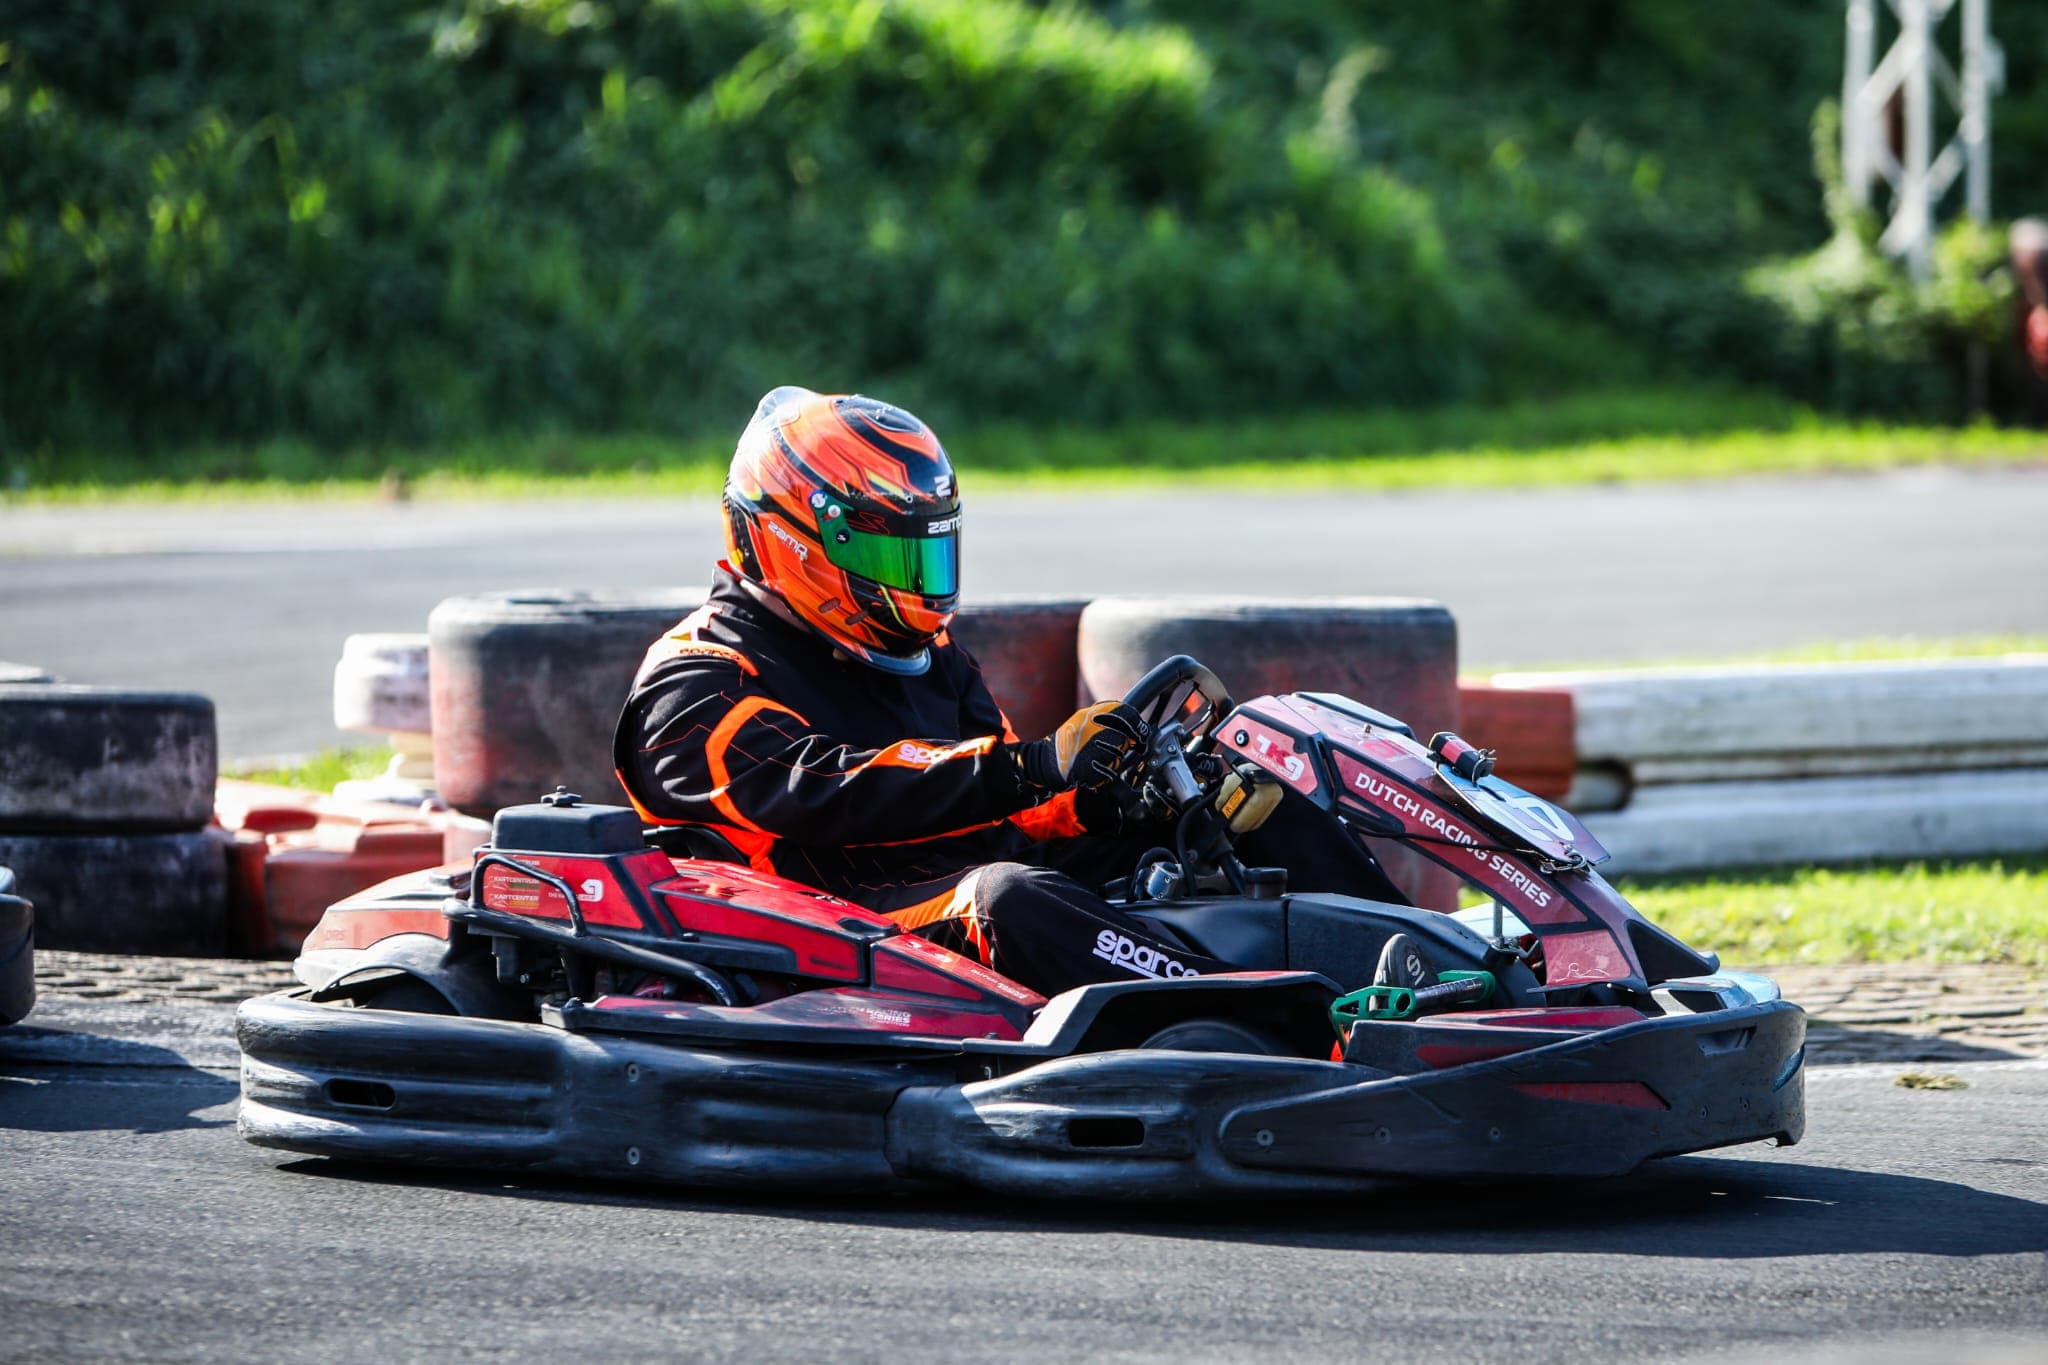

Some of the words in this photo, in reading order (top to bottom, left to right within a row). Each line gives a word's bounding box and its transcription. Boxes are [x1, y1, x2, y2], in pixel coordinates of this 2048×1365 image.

[1354, 772, 1421, 817] DUTCH
[1419, 810, 1490, 862] RACING
[1488, 854, 1551, 908] SERIES
